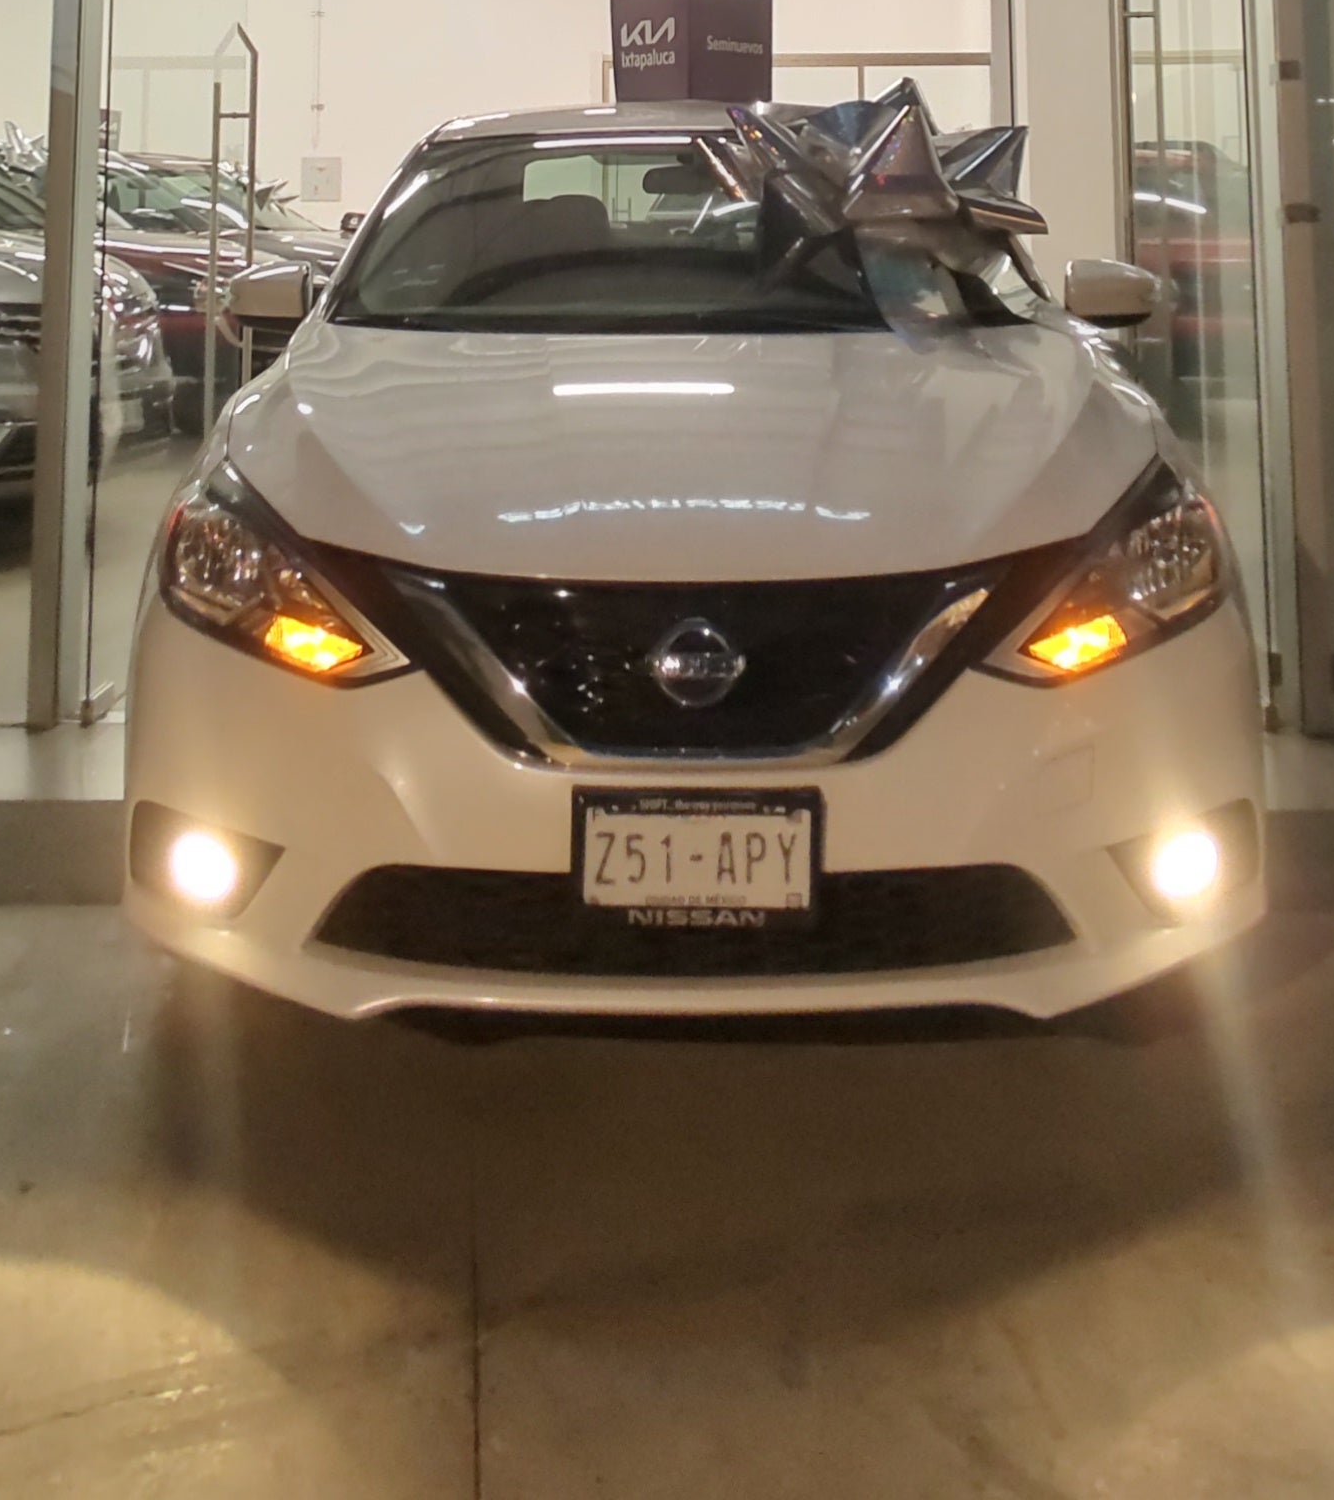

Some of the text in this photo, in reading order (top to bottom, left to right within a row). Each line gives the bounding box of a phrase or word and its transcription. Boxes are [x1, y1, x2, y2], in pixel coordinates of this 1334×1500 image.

[620, 16, 676, 48] KIA
[706, 34, 764, 55] Seminuevos
[621, 48, 676, 70] Ixtapaluca
[627, 908, 766, 927] NISSAN
